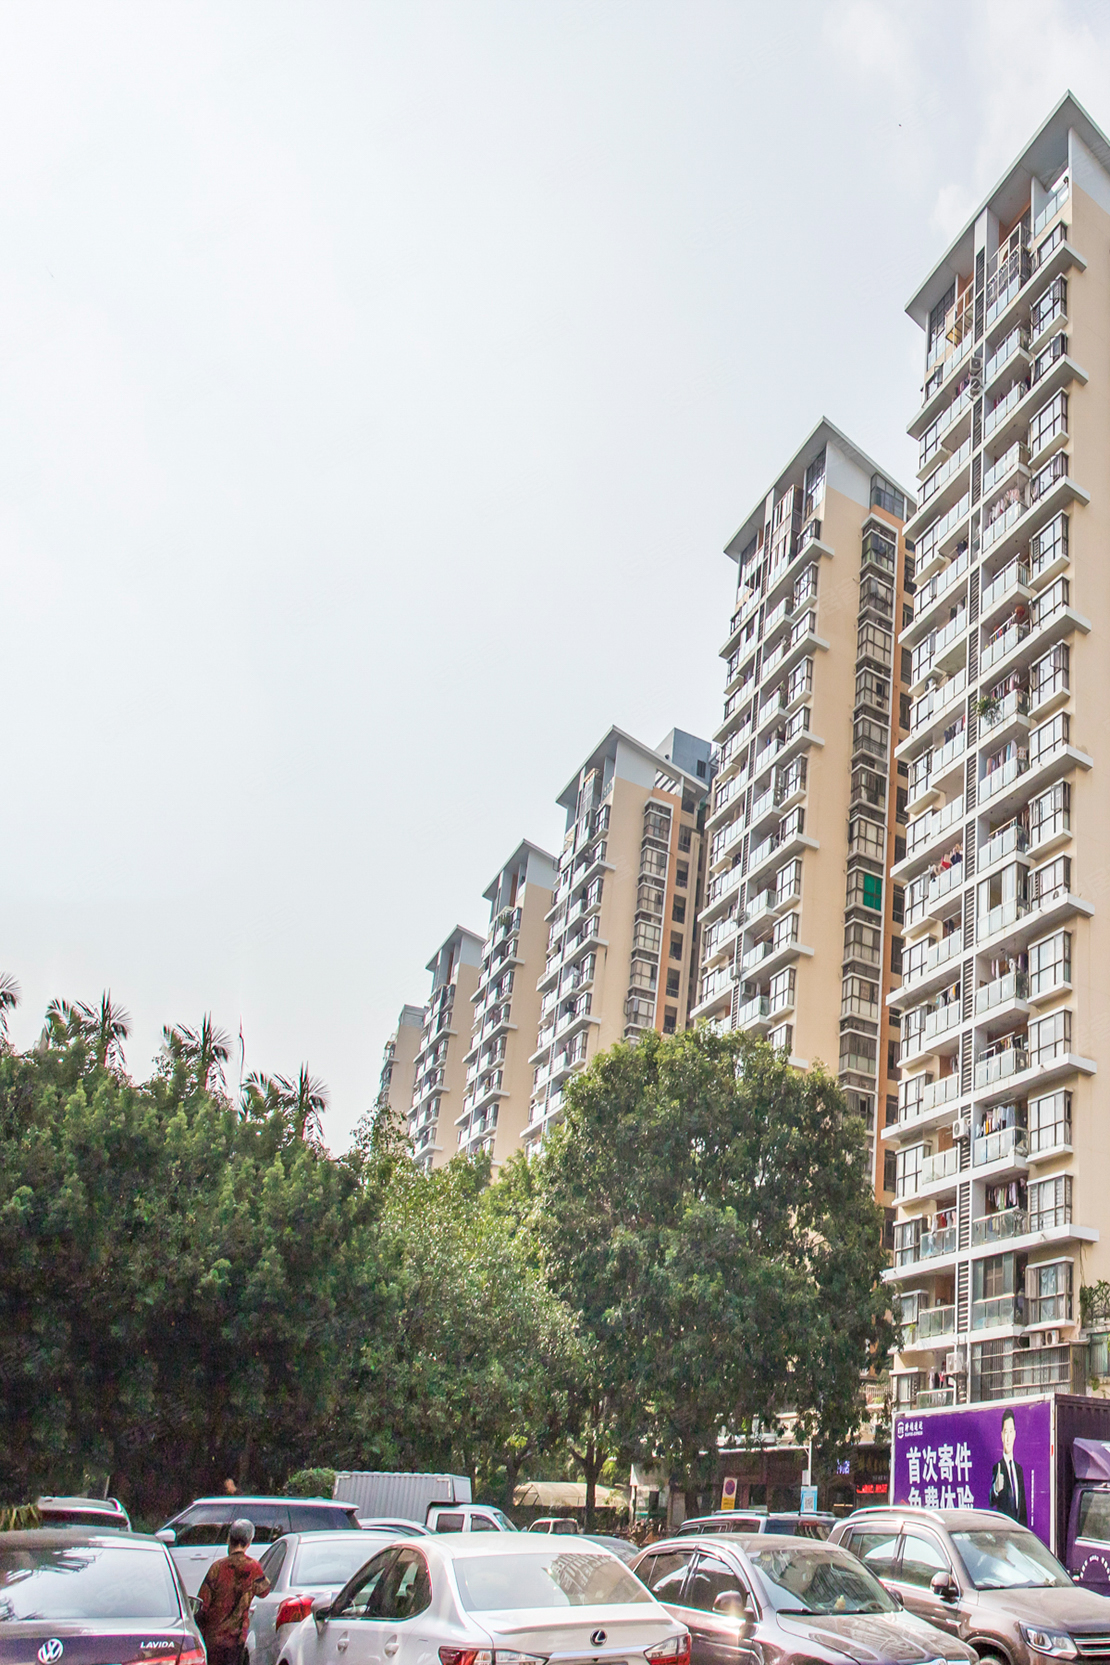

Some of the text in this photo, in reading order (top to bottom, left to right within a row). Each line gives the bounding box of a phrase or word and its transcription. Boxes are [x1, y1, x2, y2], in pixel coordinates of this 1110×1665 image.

[906, 1442, 973, 1484] 首次寄件
[140, 1640, 175, 1649] LAVIDA
